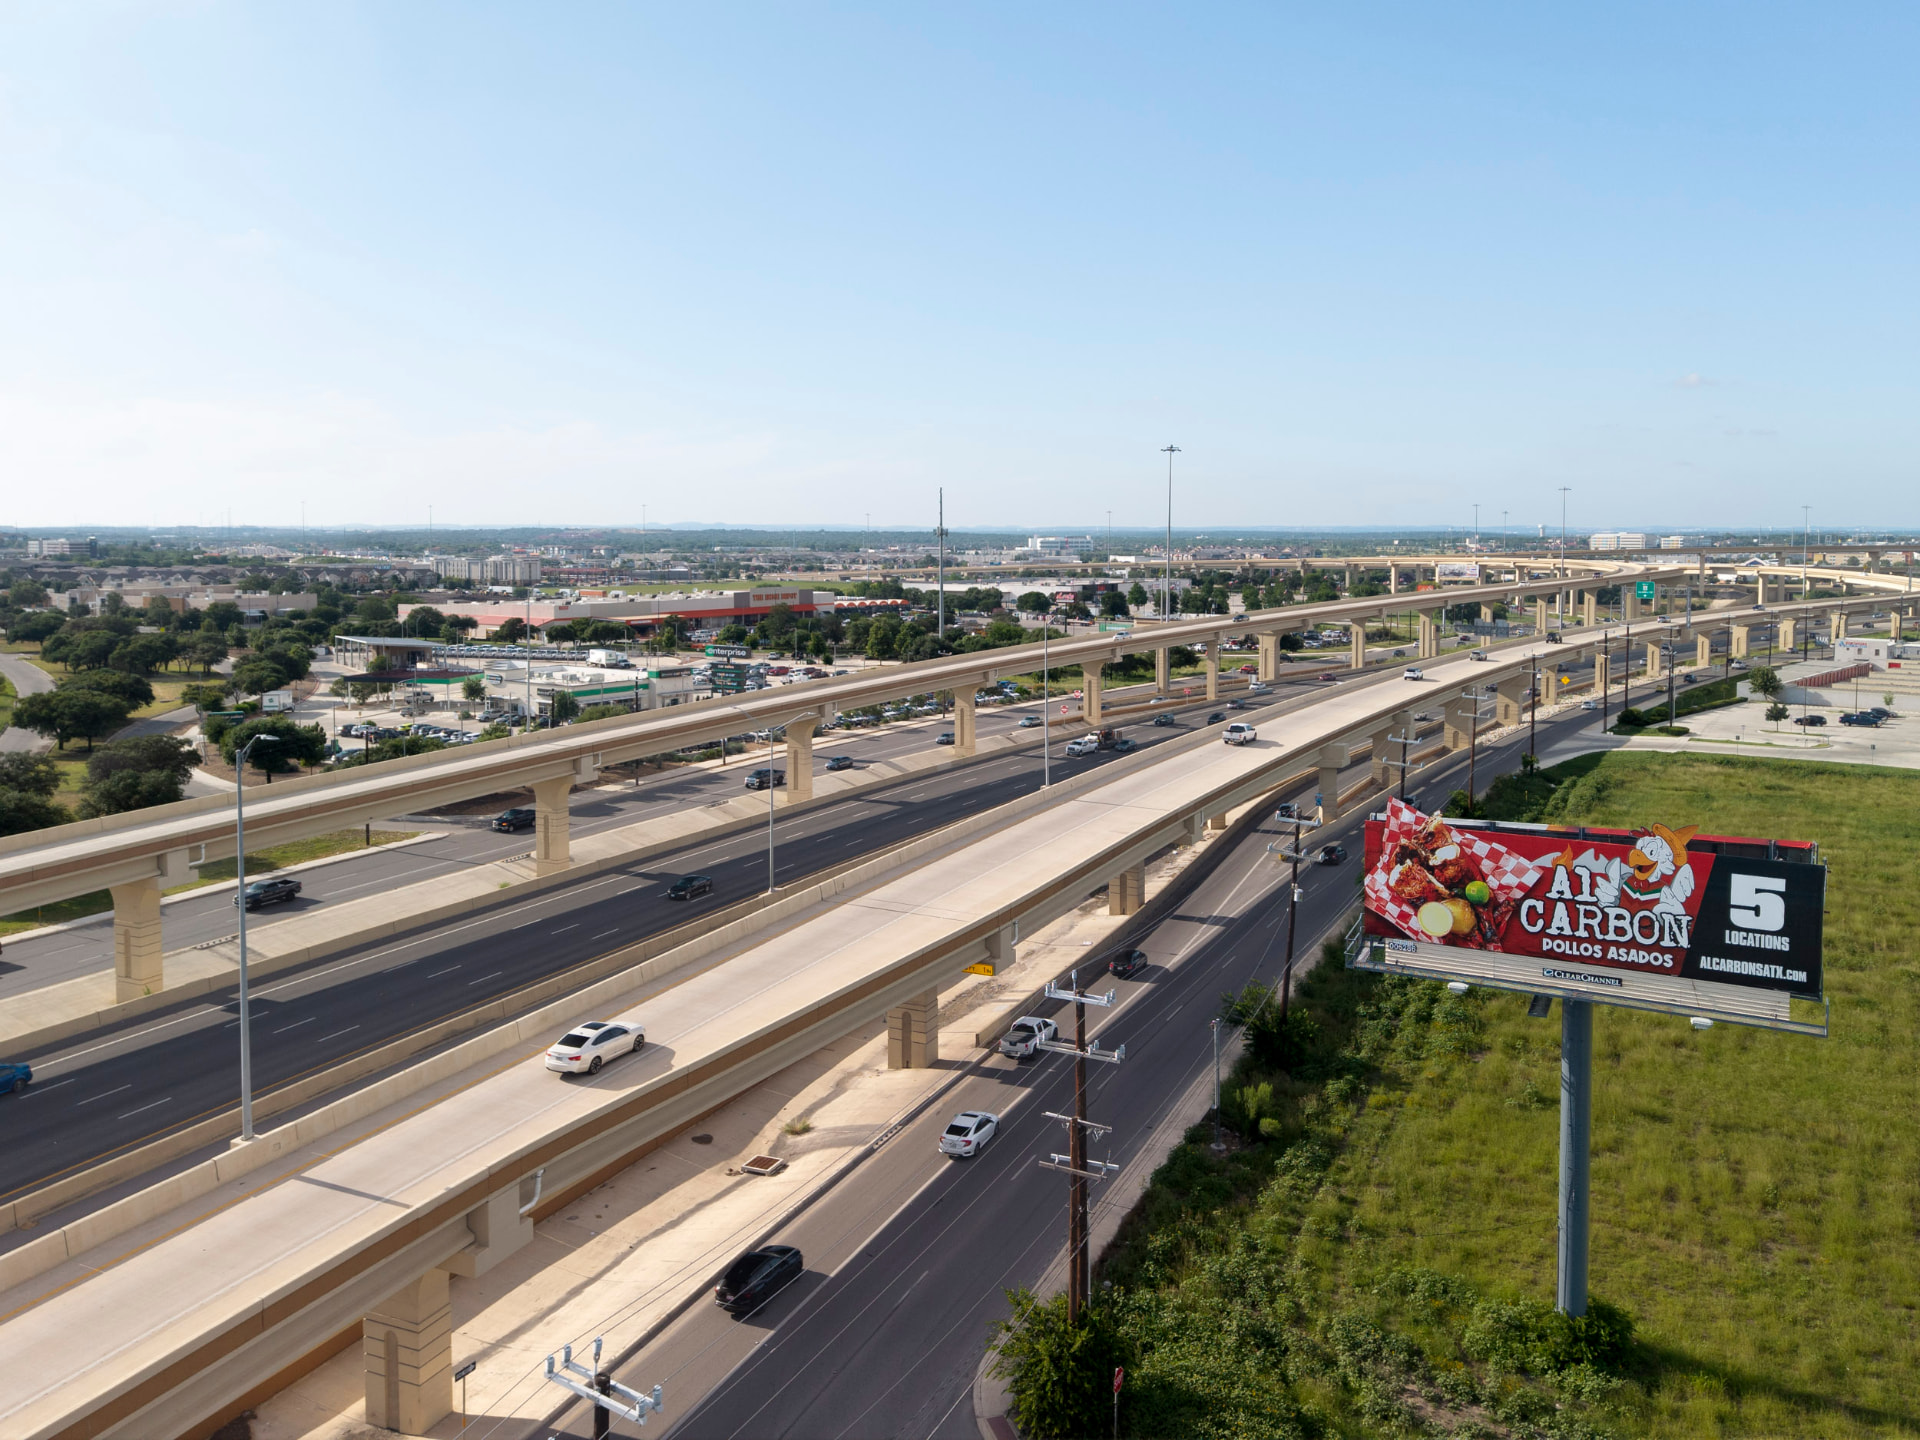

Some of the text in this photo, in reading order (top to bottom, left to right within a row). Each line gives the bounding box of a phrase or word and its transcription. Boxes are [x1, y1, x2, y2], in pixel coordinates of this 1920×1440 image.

[707, 648, 746, 657] enterprise
[1730, 873, 1786, 932] 5
[1520, 898, 1693, 949] CARBON
[1542, 937, 1674, 968] POLLOS ASADOS
[1725, 929, 1790, 952] LOCATIONS
[1699, 955, 1807, 983] ALCARBONSATX.COM
